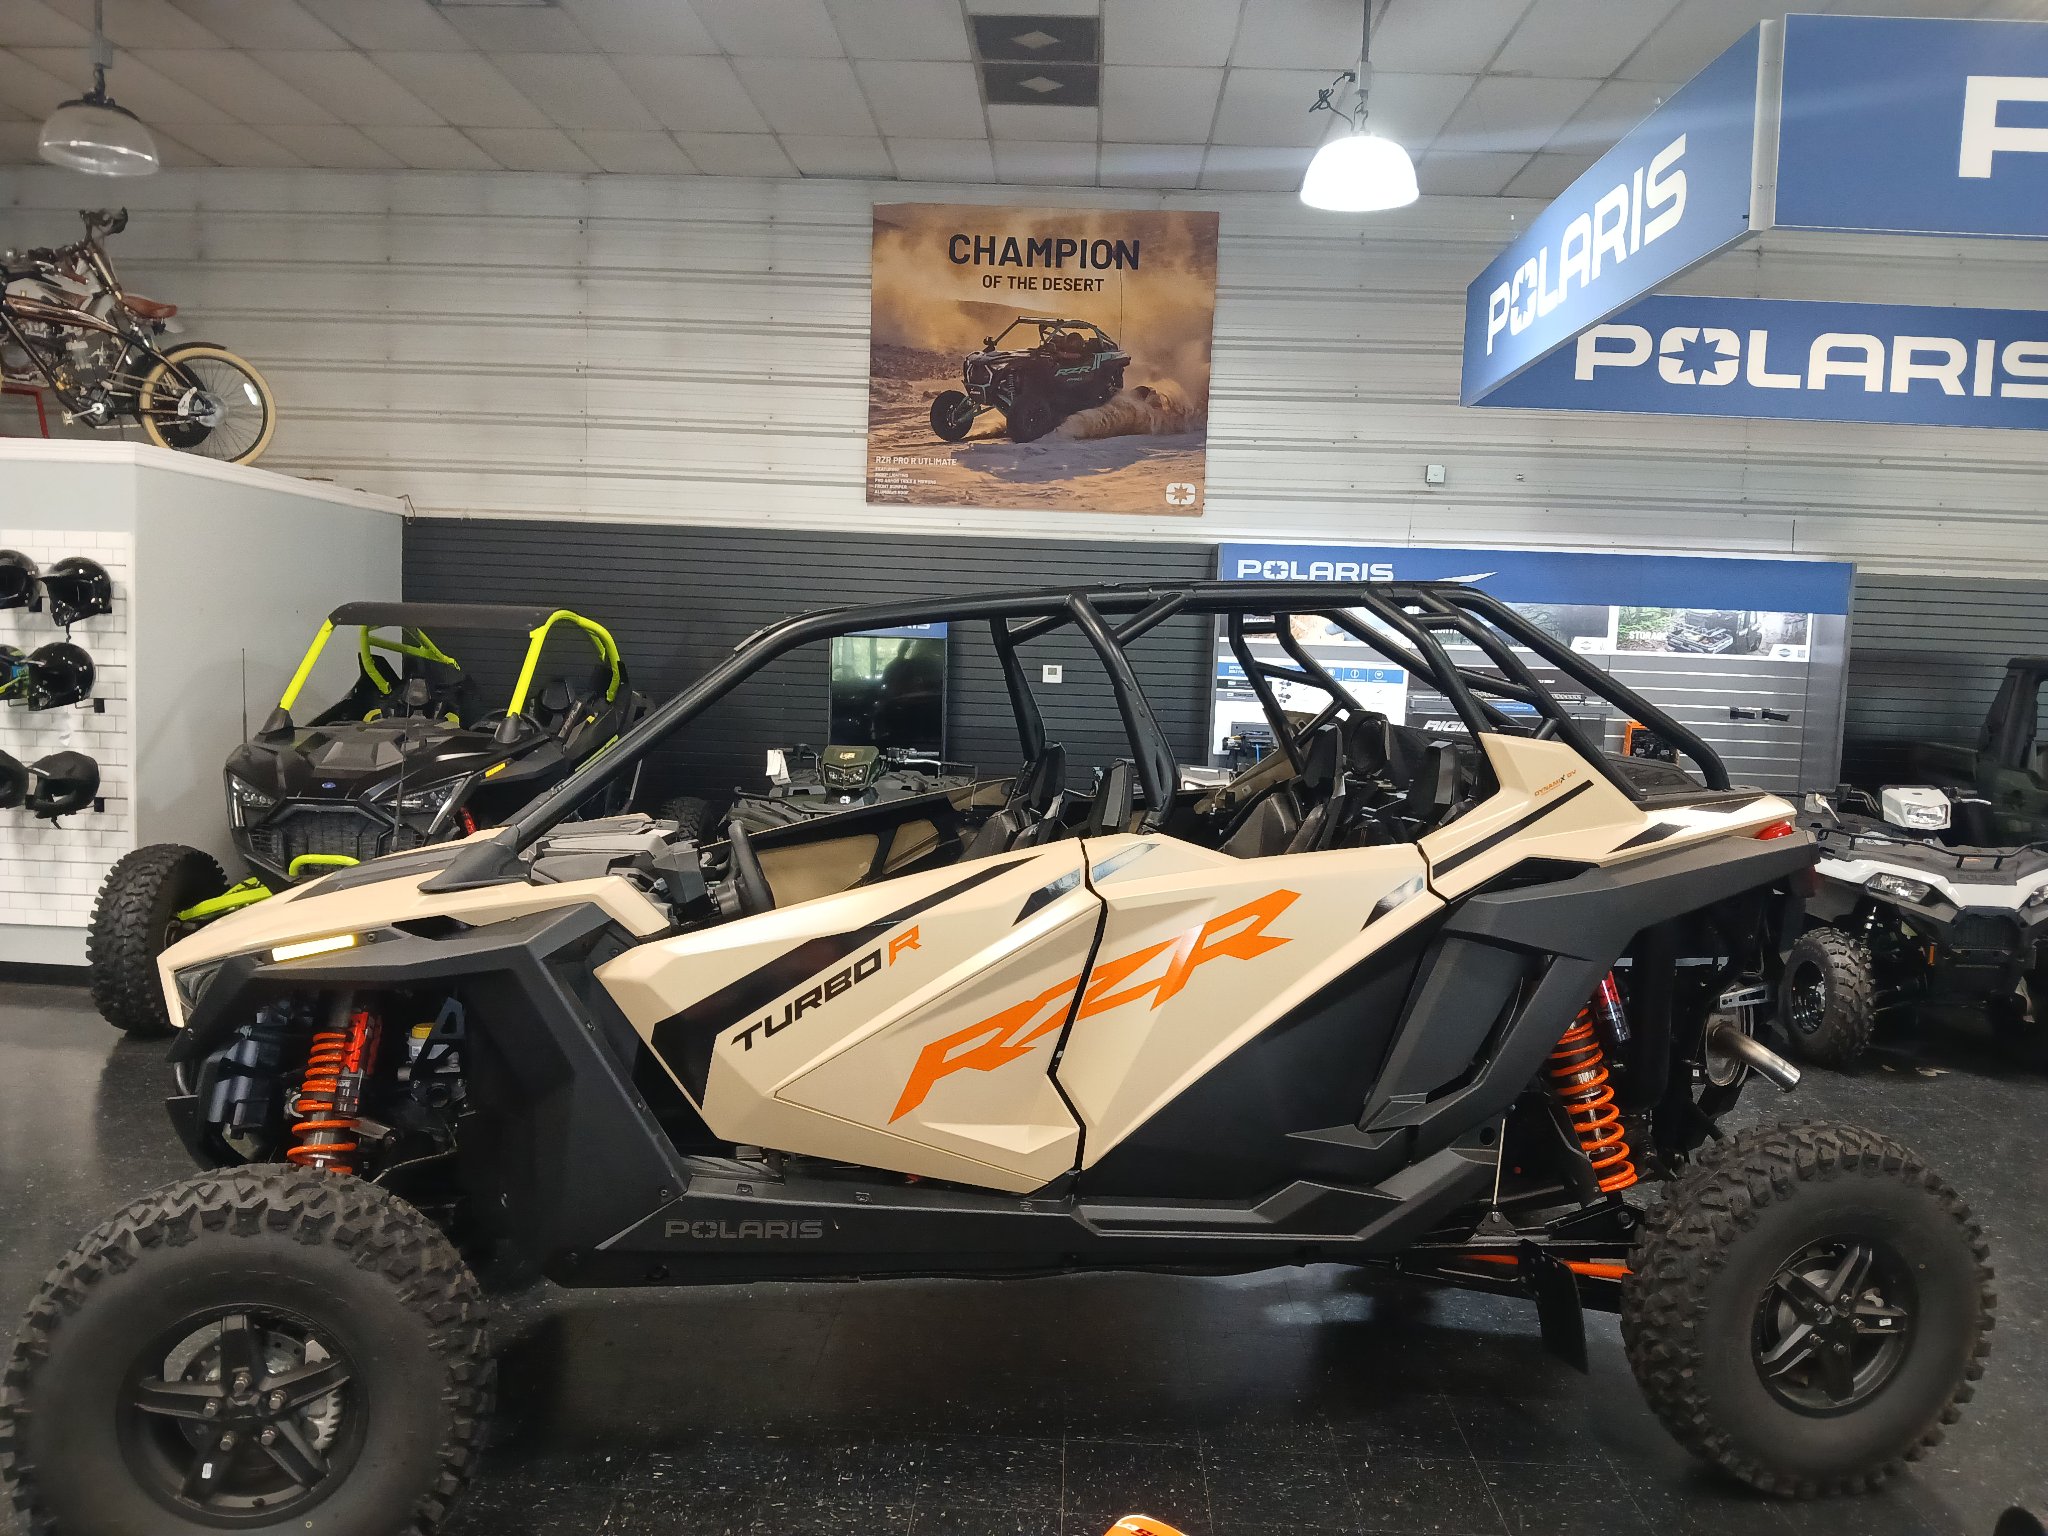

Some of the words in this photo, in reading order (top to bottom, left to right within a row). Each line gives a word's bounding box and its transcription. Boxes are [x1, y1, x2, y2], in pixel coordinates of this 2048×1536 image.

[949, 233, 1140, 270] CHAMPION
[1486, 132, 1687, 356] POLARIS
[982, 274, 1002, 288] OF
[1007, 275, 1037, 290] THE
[1042, 277, 1104, 291] DESERT
[1574, 323, 2048, 400] POLARIS
[875, 456, 891, 464] RZR
[893, 456, 909, 465] PRO
[910, 457, 917, 465] R
[918, 458, 957, 466] UTLIMATE
[1237, 559, 1394, 582] POLARIS
[731, 948, 882, 1052] TURBO
[889, 925, 922, 967] R
[887, 888, 1302, 1125] RZR
[664, 1219, 824, 1239] POLARIS
